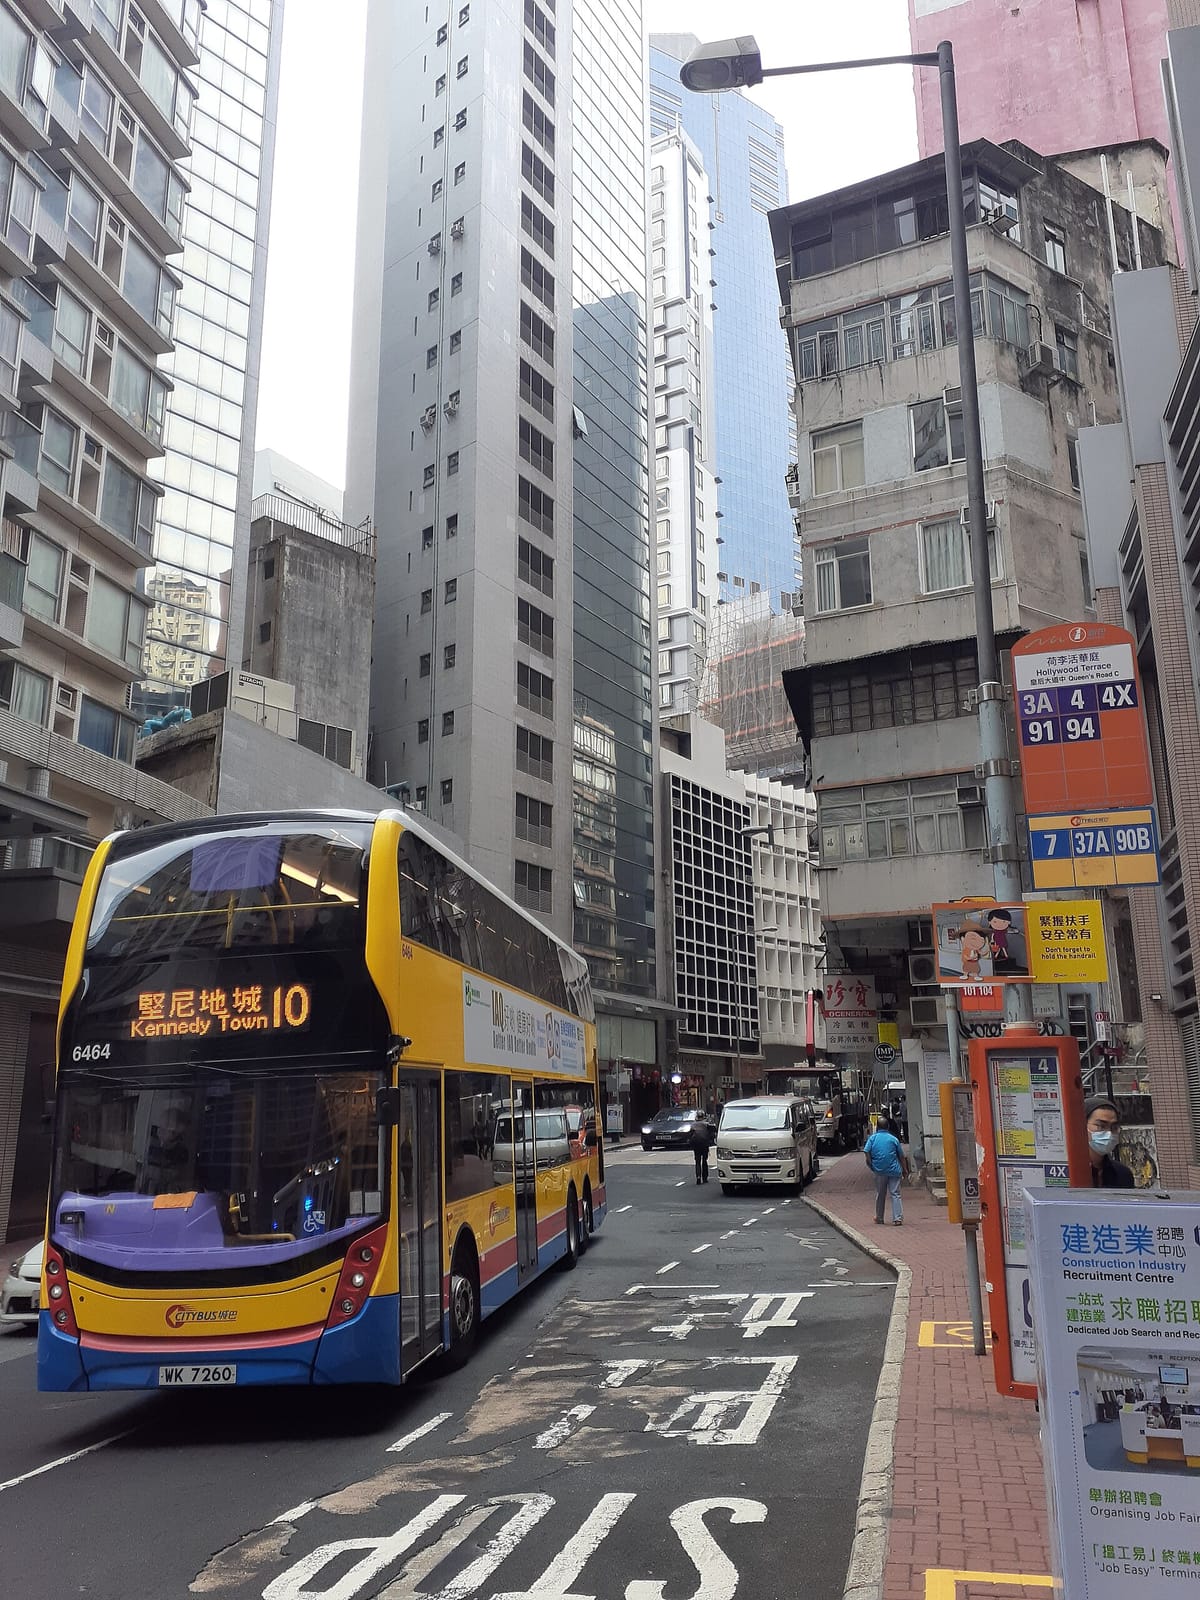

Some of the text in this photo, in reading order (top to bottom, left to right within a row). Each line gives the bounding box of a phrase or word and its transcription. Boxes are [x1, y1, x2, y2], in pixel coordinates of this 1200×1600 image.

[1047, 652, 1100, 666] 荷李活華庭
[1036, 663, 1112, 677] Hollywood Terrace
[1068, 673, 1095, 682] Queen's
[1096, 671, 1113, 679] Road
[239, 674, 264, 687] HITACHI
[1023, 684, 1134, 715] 3A 4 4X
[1028, 717, 1095, 743] 91 94
[1044, 828, 1150, 856] 7 37A 90B
[1039, 914, 1090, 927] 緊握扶手
[1041, 928, 1091, 941] 安全常有
[1062, 946, 1082, 954] forget
[963, 985, 993, 996] 101 104
[138, 986, 263, 1021] 堅尼地城
[273, 984, 310, 1028] 10
[130, 1014, 268, 1038] Kennedy Town
[72, 1043, 111, 1061] 6464
[1038, 1058, 1048, 1073] 4
[1049, 1166, 1067, 1177] 4X
[1060, 1224, 1155, 1255] 建造業
[1156, 1226, 1185, 1241] 招聘
[1158, 1244, 1186, 1258] 中心
[1062, 1257, 1186, 1273] Construction Industry
[1063, 1270, 1174, 1283] Recruitment Centre
[1066, 1292, 1104, 1306] 一站式
[175, 1311, 218, 1320] CITYBUS
[1066, 1308, 1105, 1323] 建造業
[1067, 1325, 1110, 1335] Dedicated
[1112, 1328, 1129, 1336] Job
[1131, 1328, 1161, 1337] Search
[1164, 1330, 1181, 1338] and
[165, 1367, 232, 1383] WK 7260
[1089, 1488, 1162, 1506] 舉辦招聘會
[1090, 1506, 1150, 1521] Organising
[1154, 1511, 1175, 1521] Job
[261, 1493, 768, 1600] STOP
